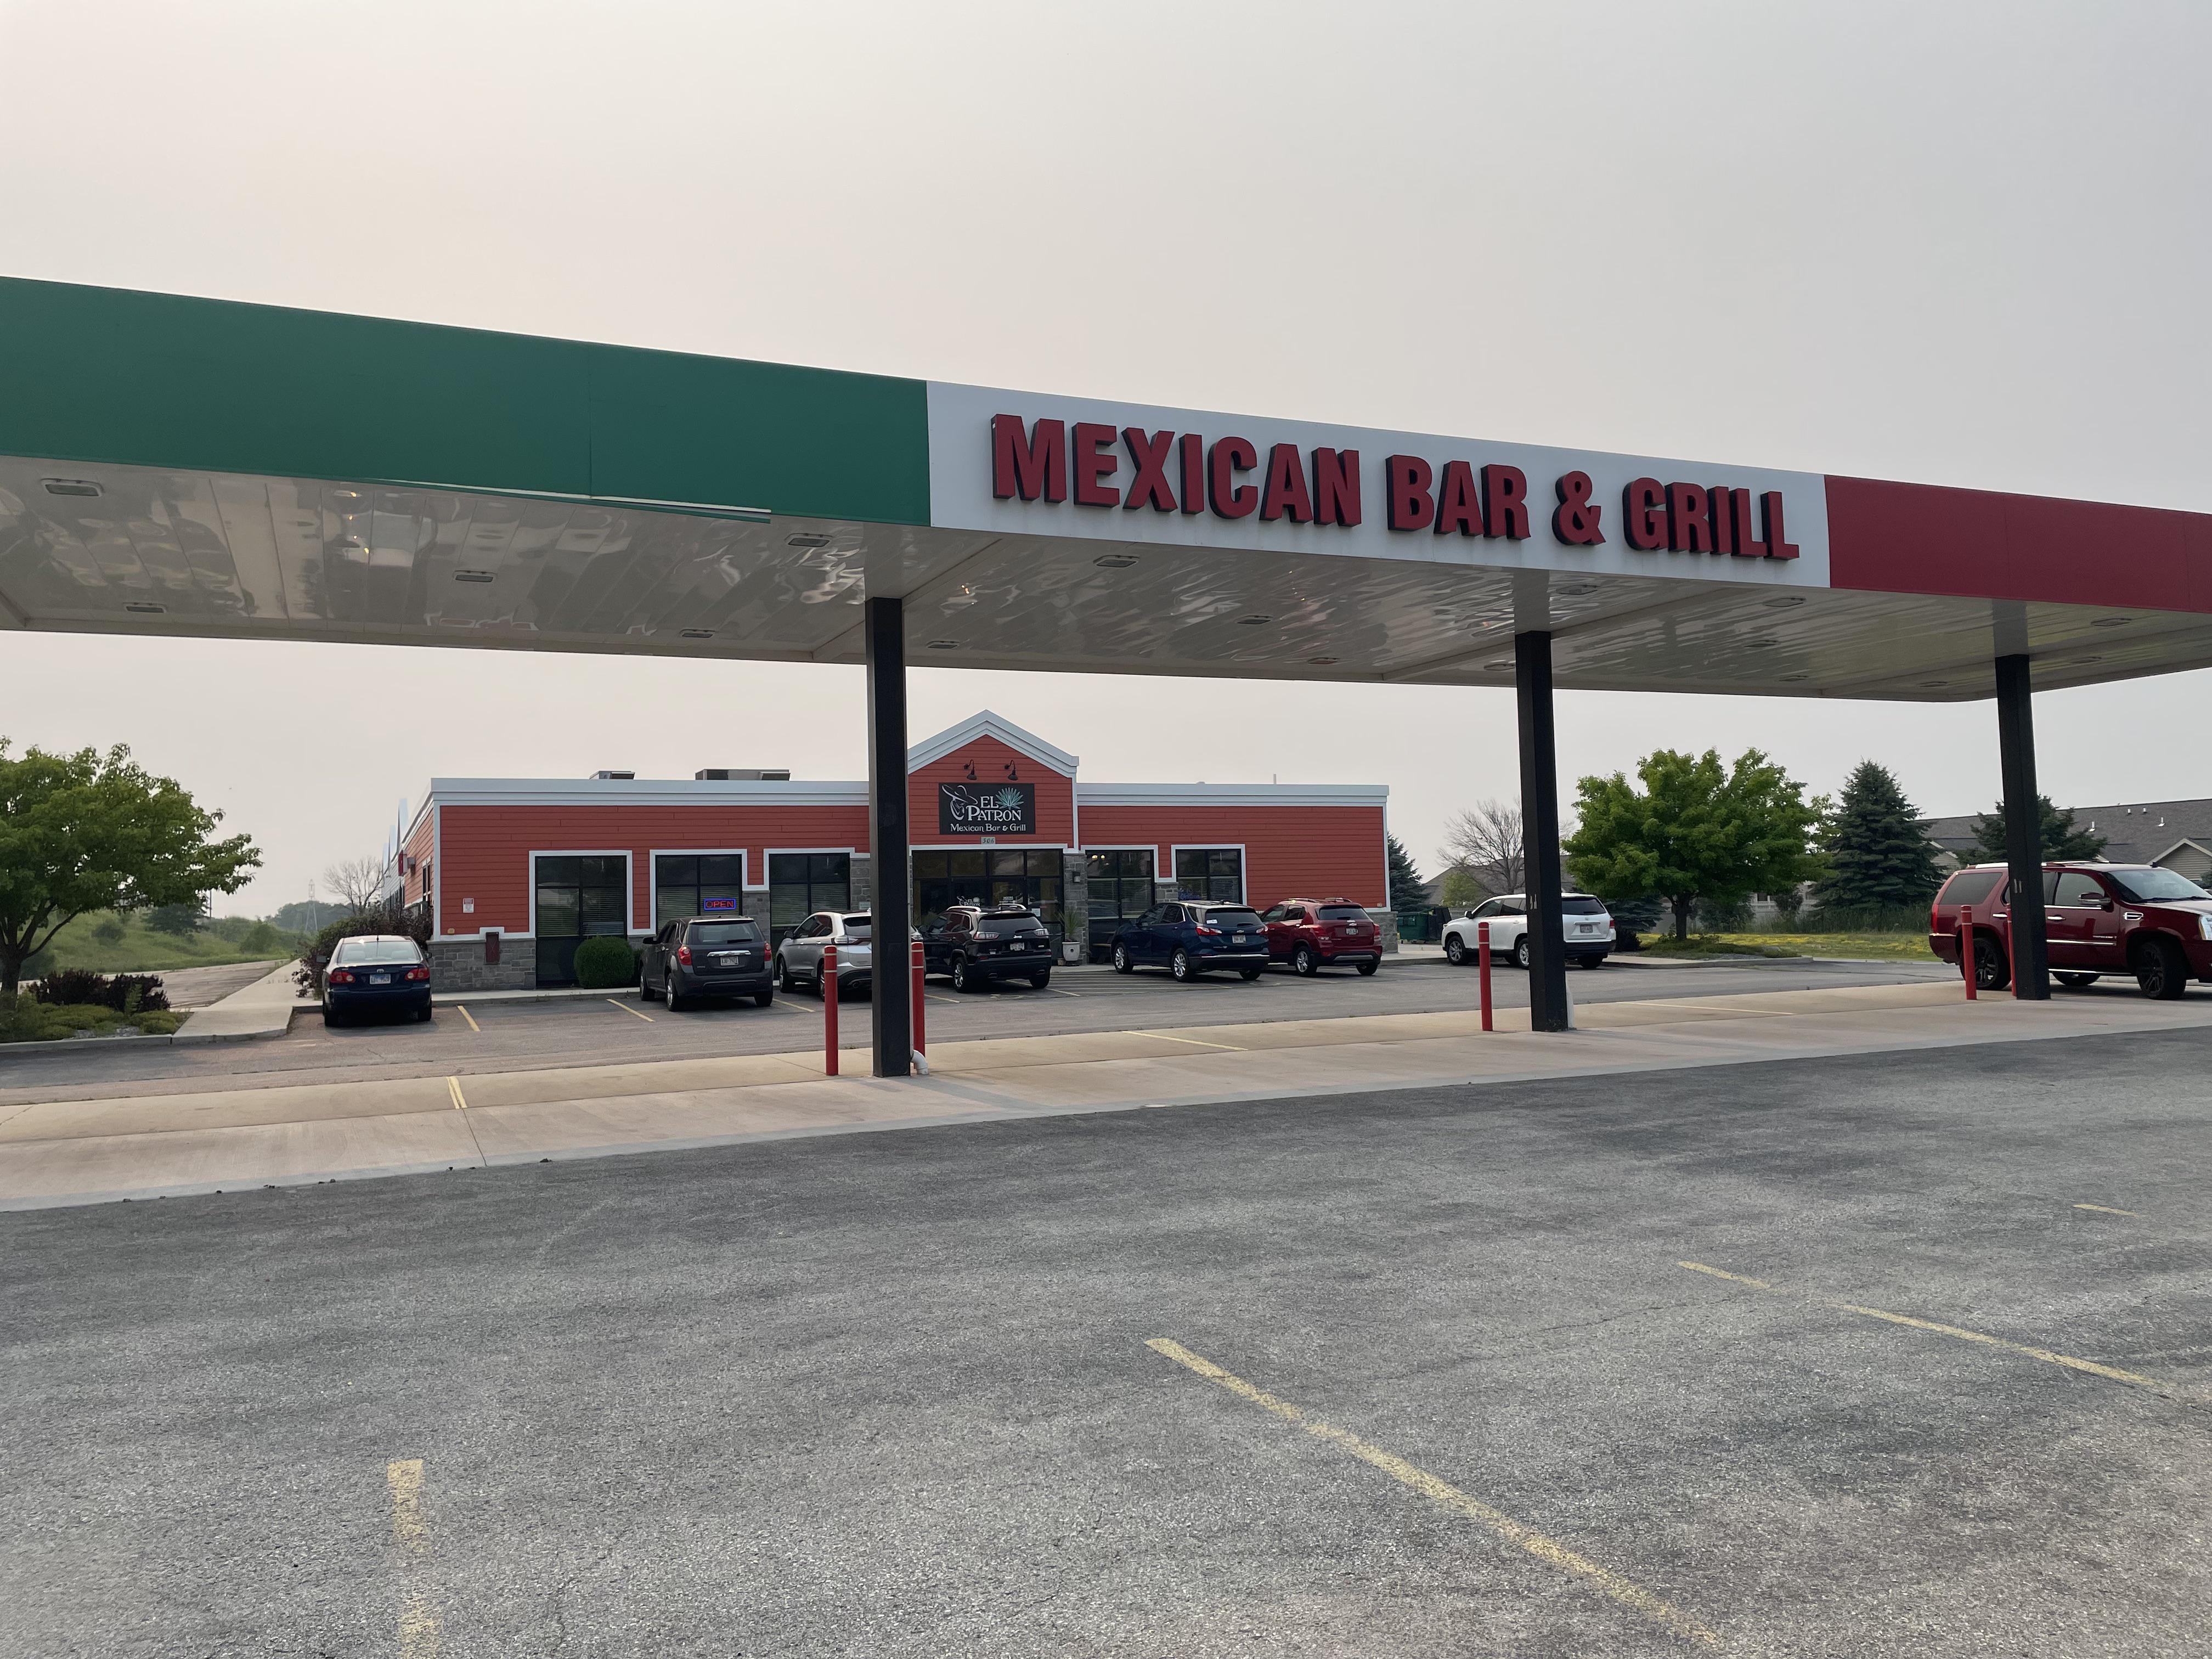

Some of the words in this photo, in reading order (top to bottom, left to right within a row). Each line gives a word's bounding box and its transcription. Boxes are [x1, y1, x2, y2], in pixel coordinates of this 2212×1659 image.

[991, 414, 1362, 527] MEXICAN
[1385, 454, 1531, 539] BAR
[1551, 470, 1606, 546] &
[1622, 477, 1799, 560] GRILL
[980, 796, 998, 808] EL
[966, 805, 1021, 821] PATRON
[950, 823, 984, 832] Mexican
[1010, 823, 1026, 832] Grill
